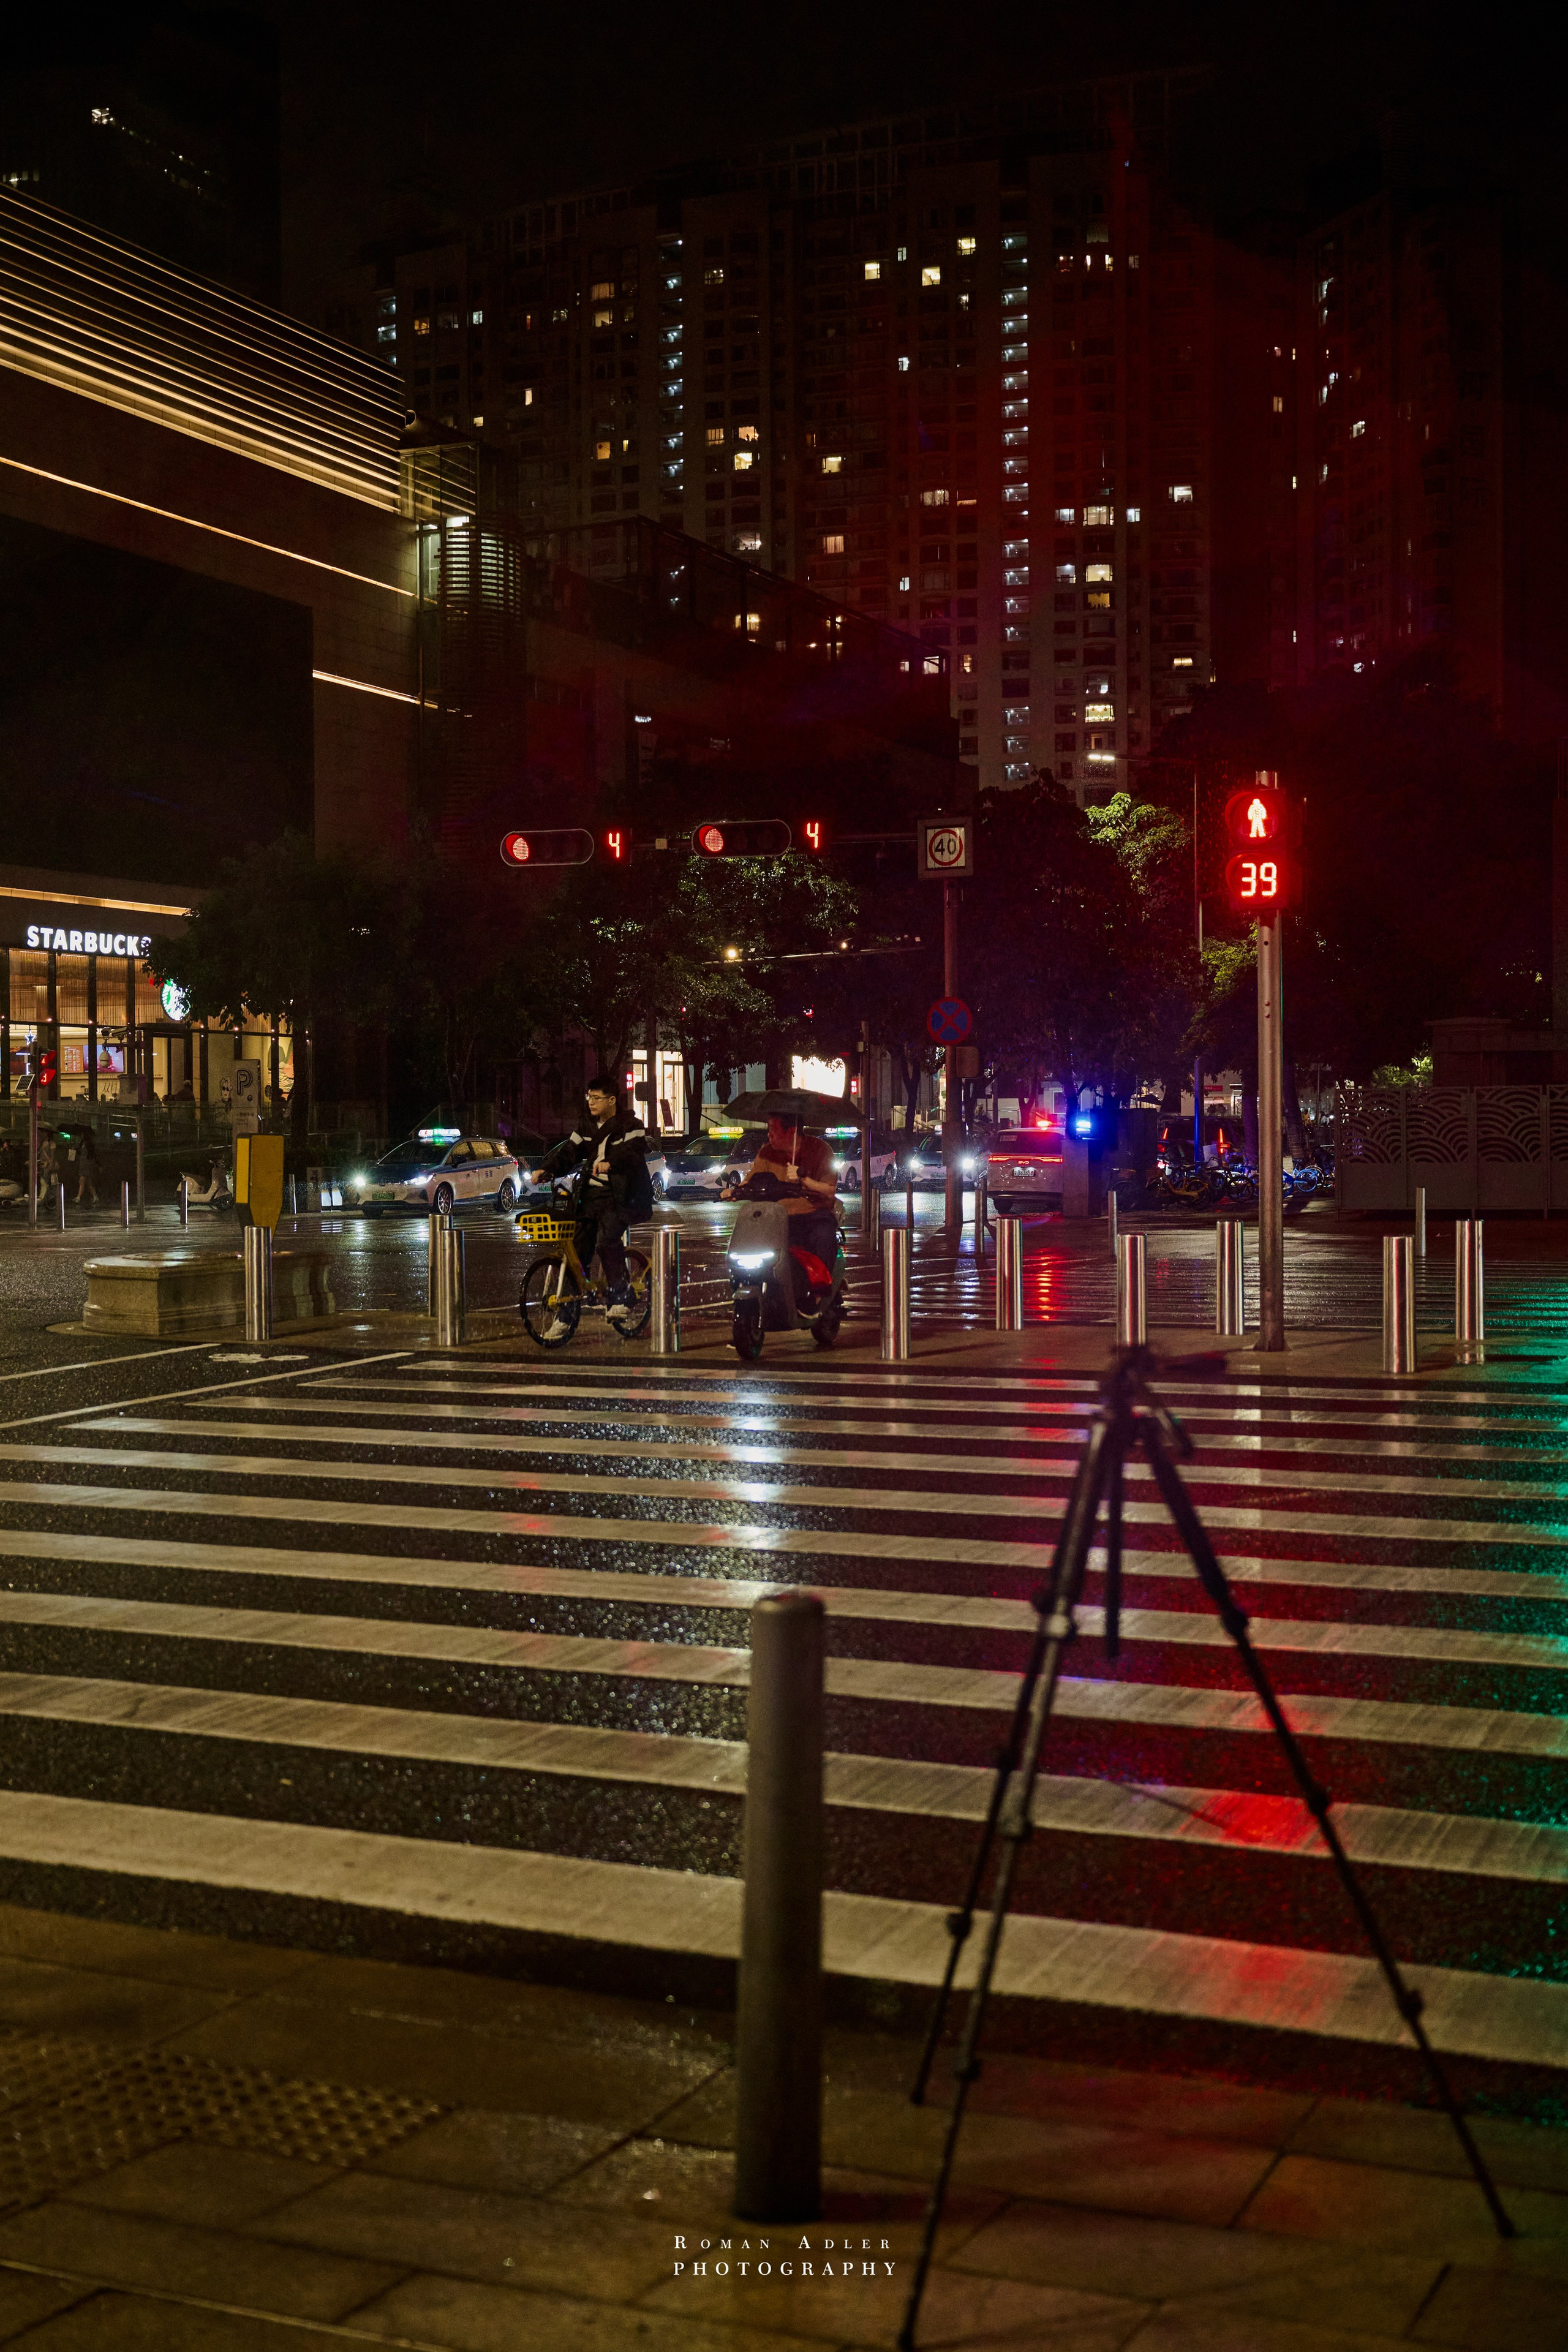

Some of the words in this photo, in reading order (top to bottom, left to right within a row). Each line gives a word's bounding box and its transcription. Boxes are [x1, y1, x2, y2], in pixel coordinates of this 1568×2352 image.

[608, 832, 620, 858] 4
[807, 823, 819, 848] 4
[934, 838, 957, 856] 40
[1241, 862, 1277, 897] 39
